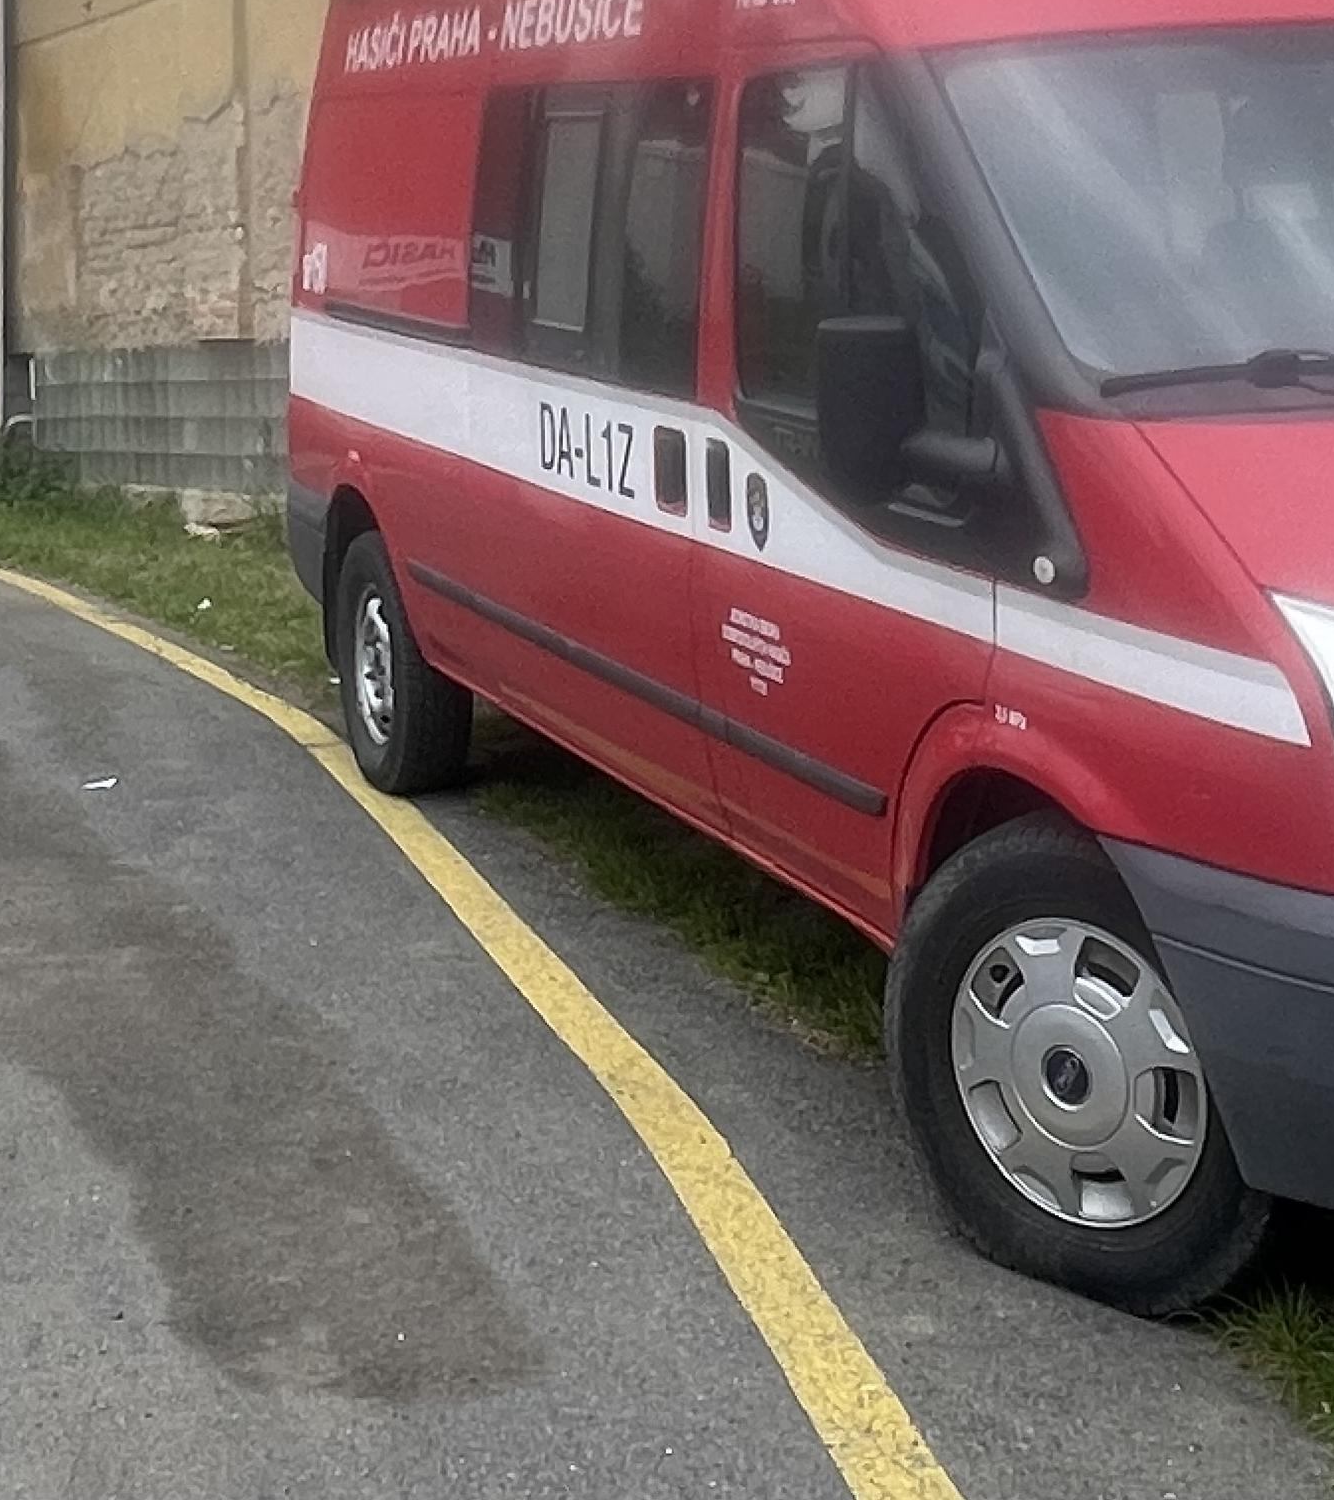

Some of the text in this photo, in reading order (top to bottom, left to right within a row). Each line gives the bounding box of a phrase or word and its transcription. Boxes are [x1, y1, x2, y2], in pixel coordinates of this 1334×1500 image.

[344, 10, 407, 73] HASIČI
[407, 4, 481, 63] PRAHA
[540, 401, 635, 499] DA-L1Z
